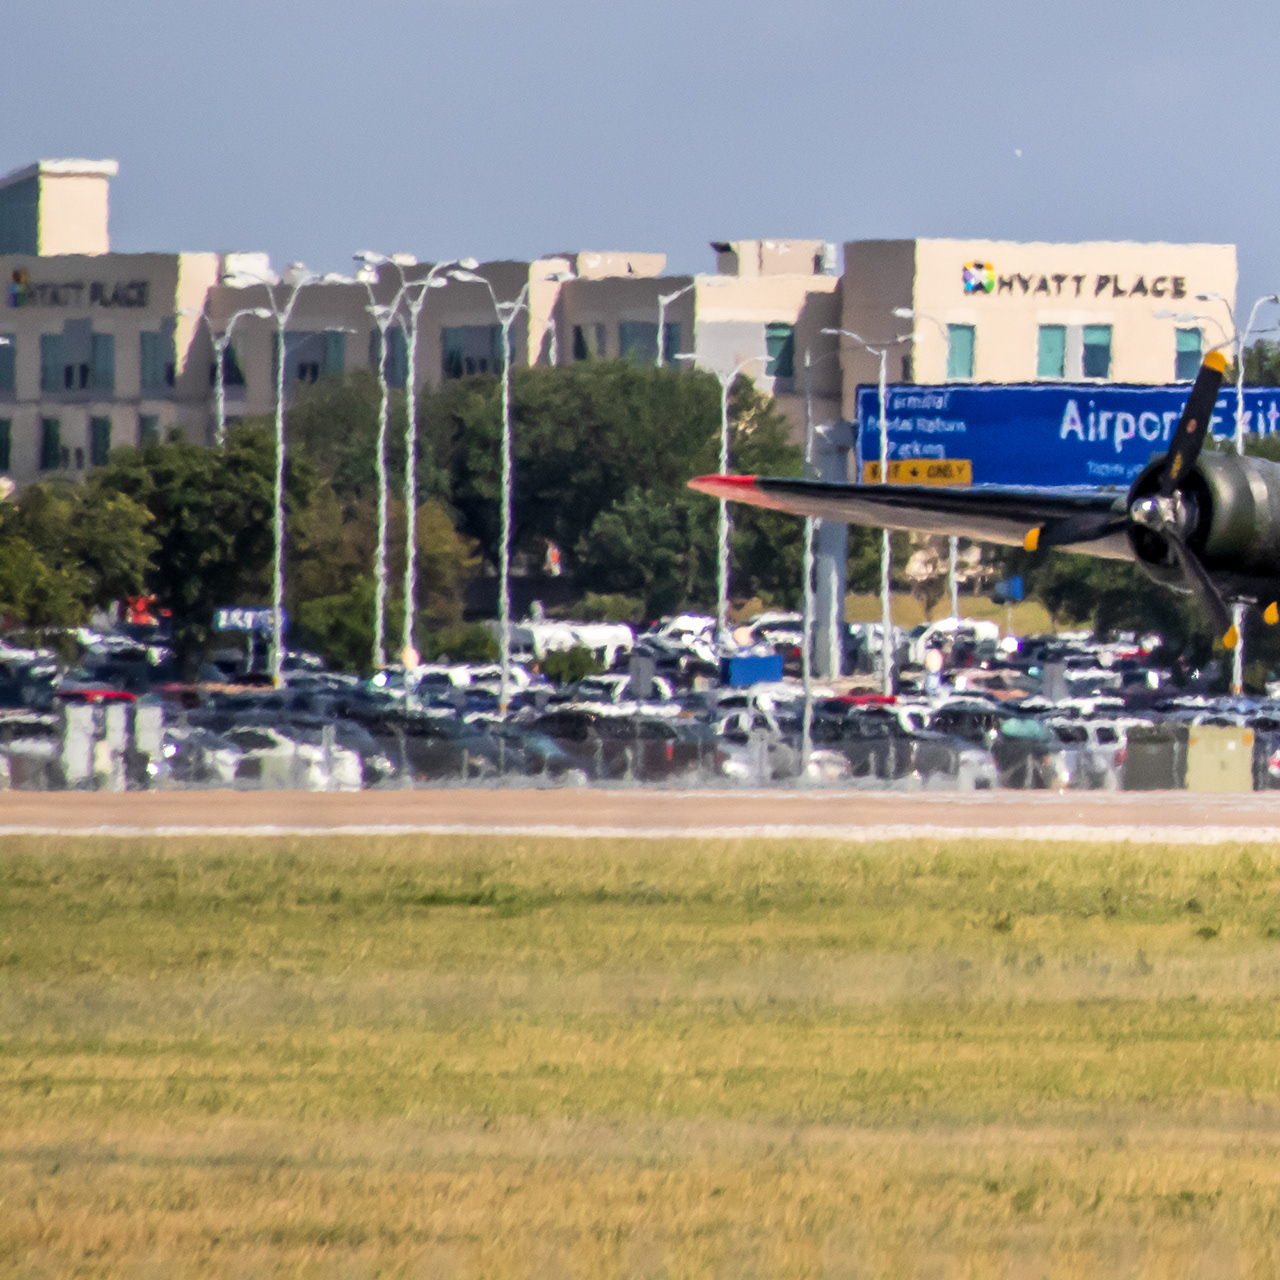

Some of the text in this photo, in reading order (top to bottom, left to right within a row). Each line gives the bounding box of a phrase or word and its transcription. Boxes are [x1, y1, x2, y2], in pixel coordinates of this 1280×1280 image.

[998, 273, 1188, 299] HYATT PLACE
[1060, 399, 1187, 453] Airpor
